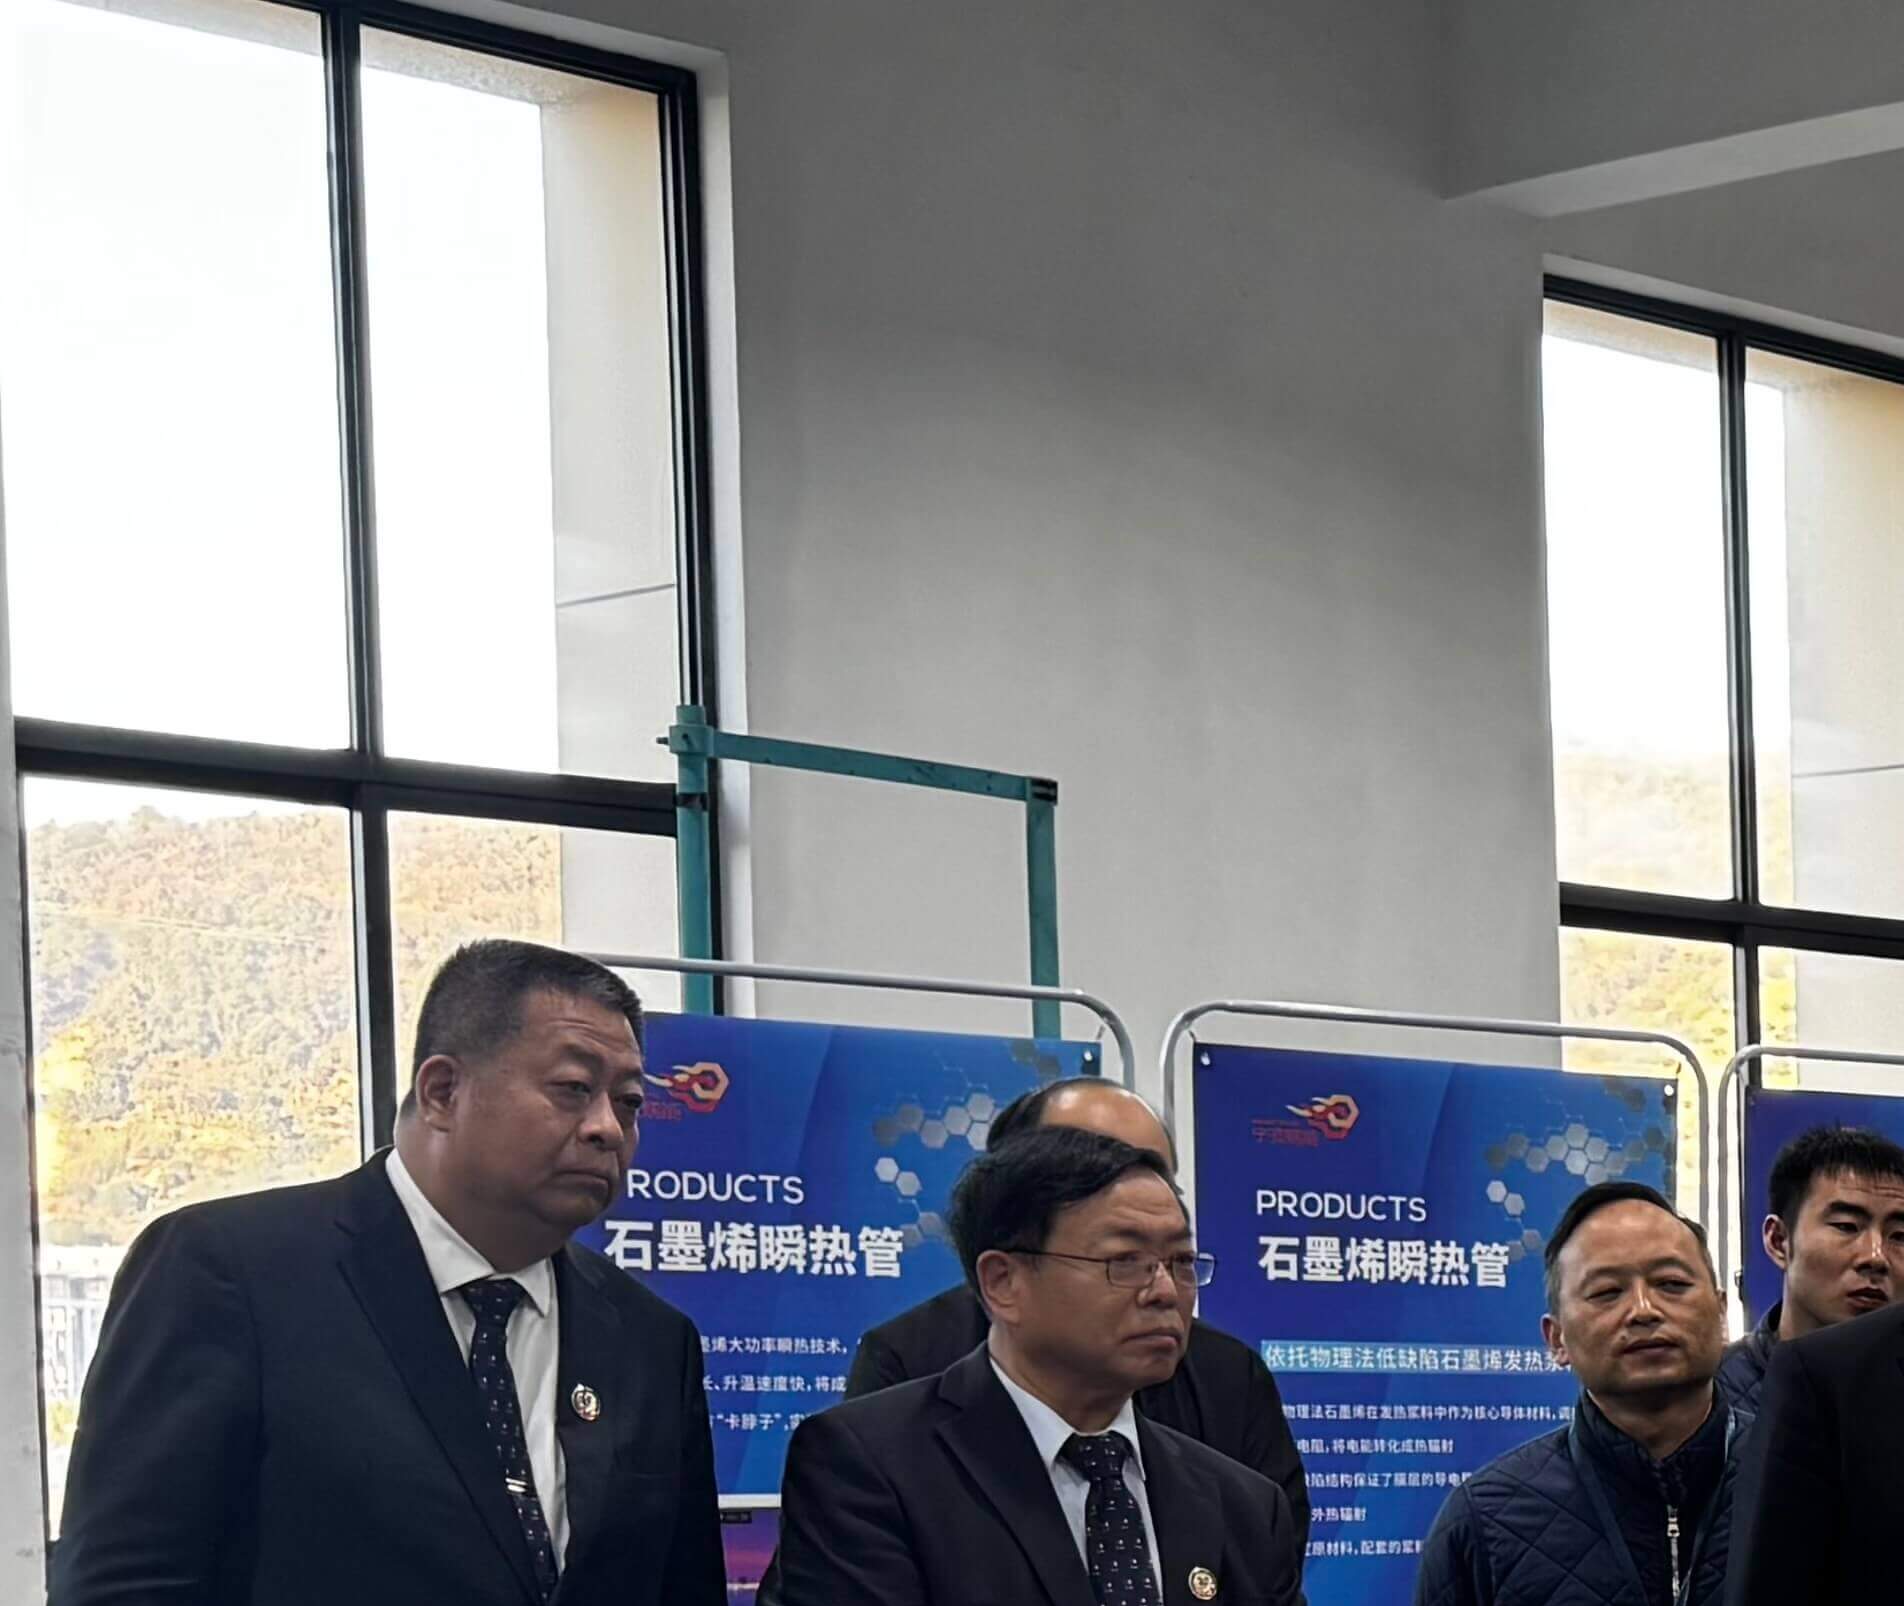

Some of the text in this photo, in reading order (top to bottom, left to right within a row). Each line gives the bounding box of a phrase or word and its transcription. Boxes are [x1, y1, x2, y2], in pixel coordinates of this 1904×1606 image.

[626, 1169, 805, 1205] RODUCTS
[1256, 1189, 1427, 1222] PRODUCTS
[604, 1219, 904, 1278] 石墨烯瞬热管
[1258, 1235, 1510, 1288] 石墨烯瞬热管
[1265, 1345, 1573, 1373] 依托物理法低缺陷石墨烯发热浆
